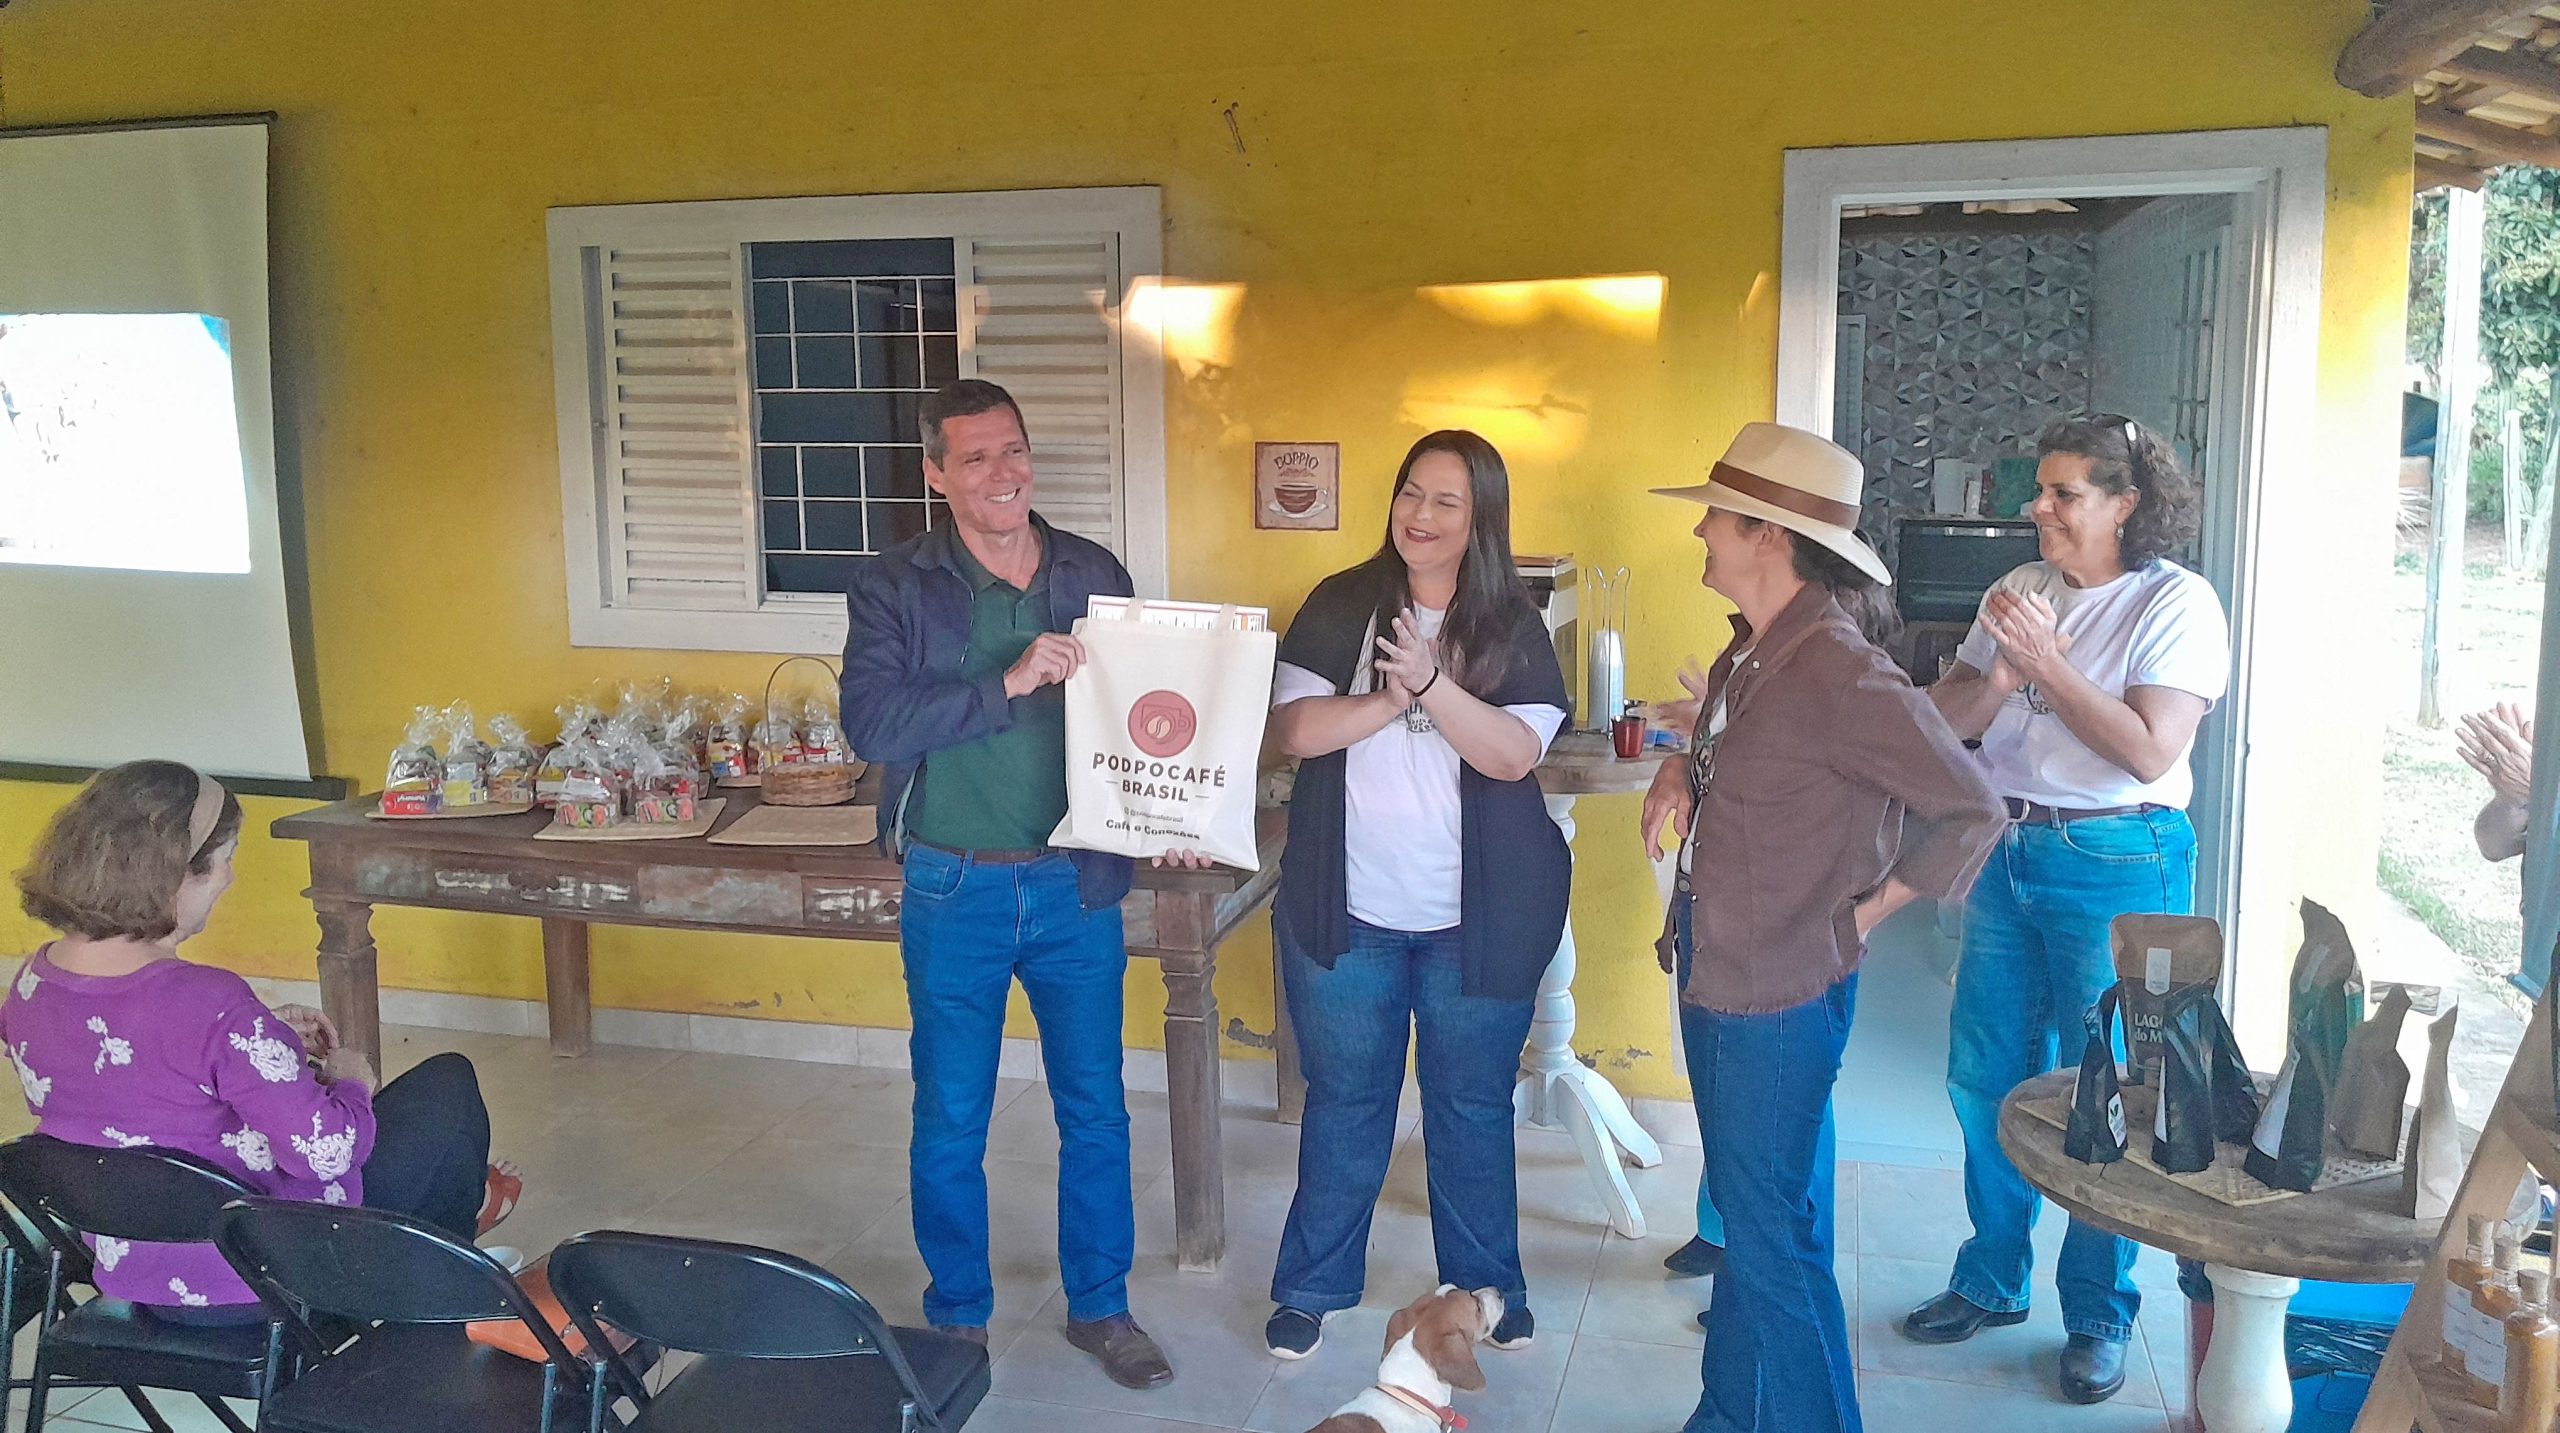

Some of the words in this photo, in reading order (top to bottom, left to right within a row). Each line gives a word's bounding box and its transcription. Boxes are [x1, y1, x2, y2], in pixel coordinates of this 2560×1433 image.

[1273, 451, 1320, 470] DOPPIO
[1092, 752, 1226, 788] PODPOCAFÉ
[1122, 779, 1189, 802] BRASIL
